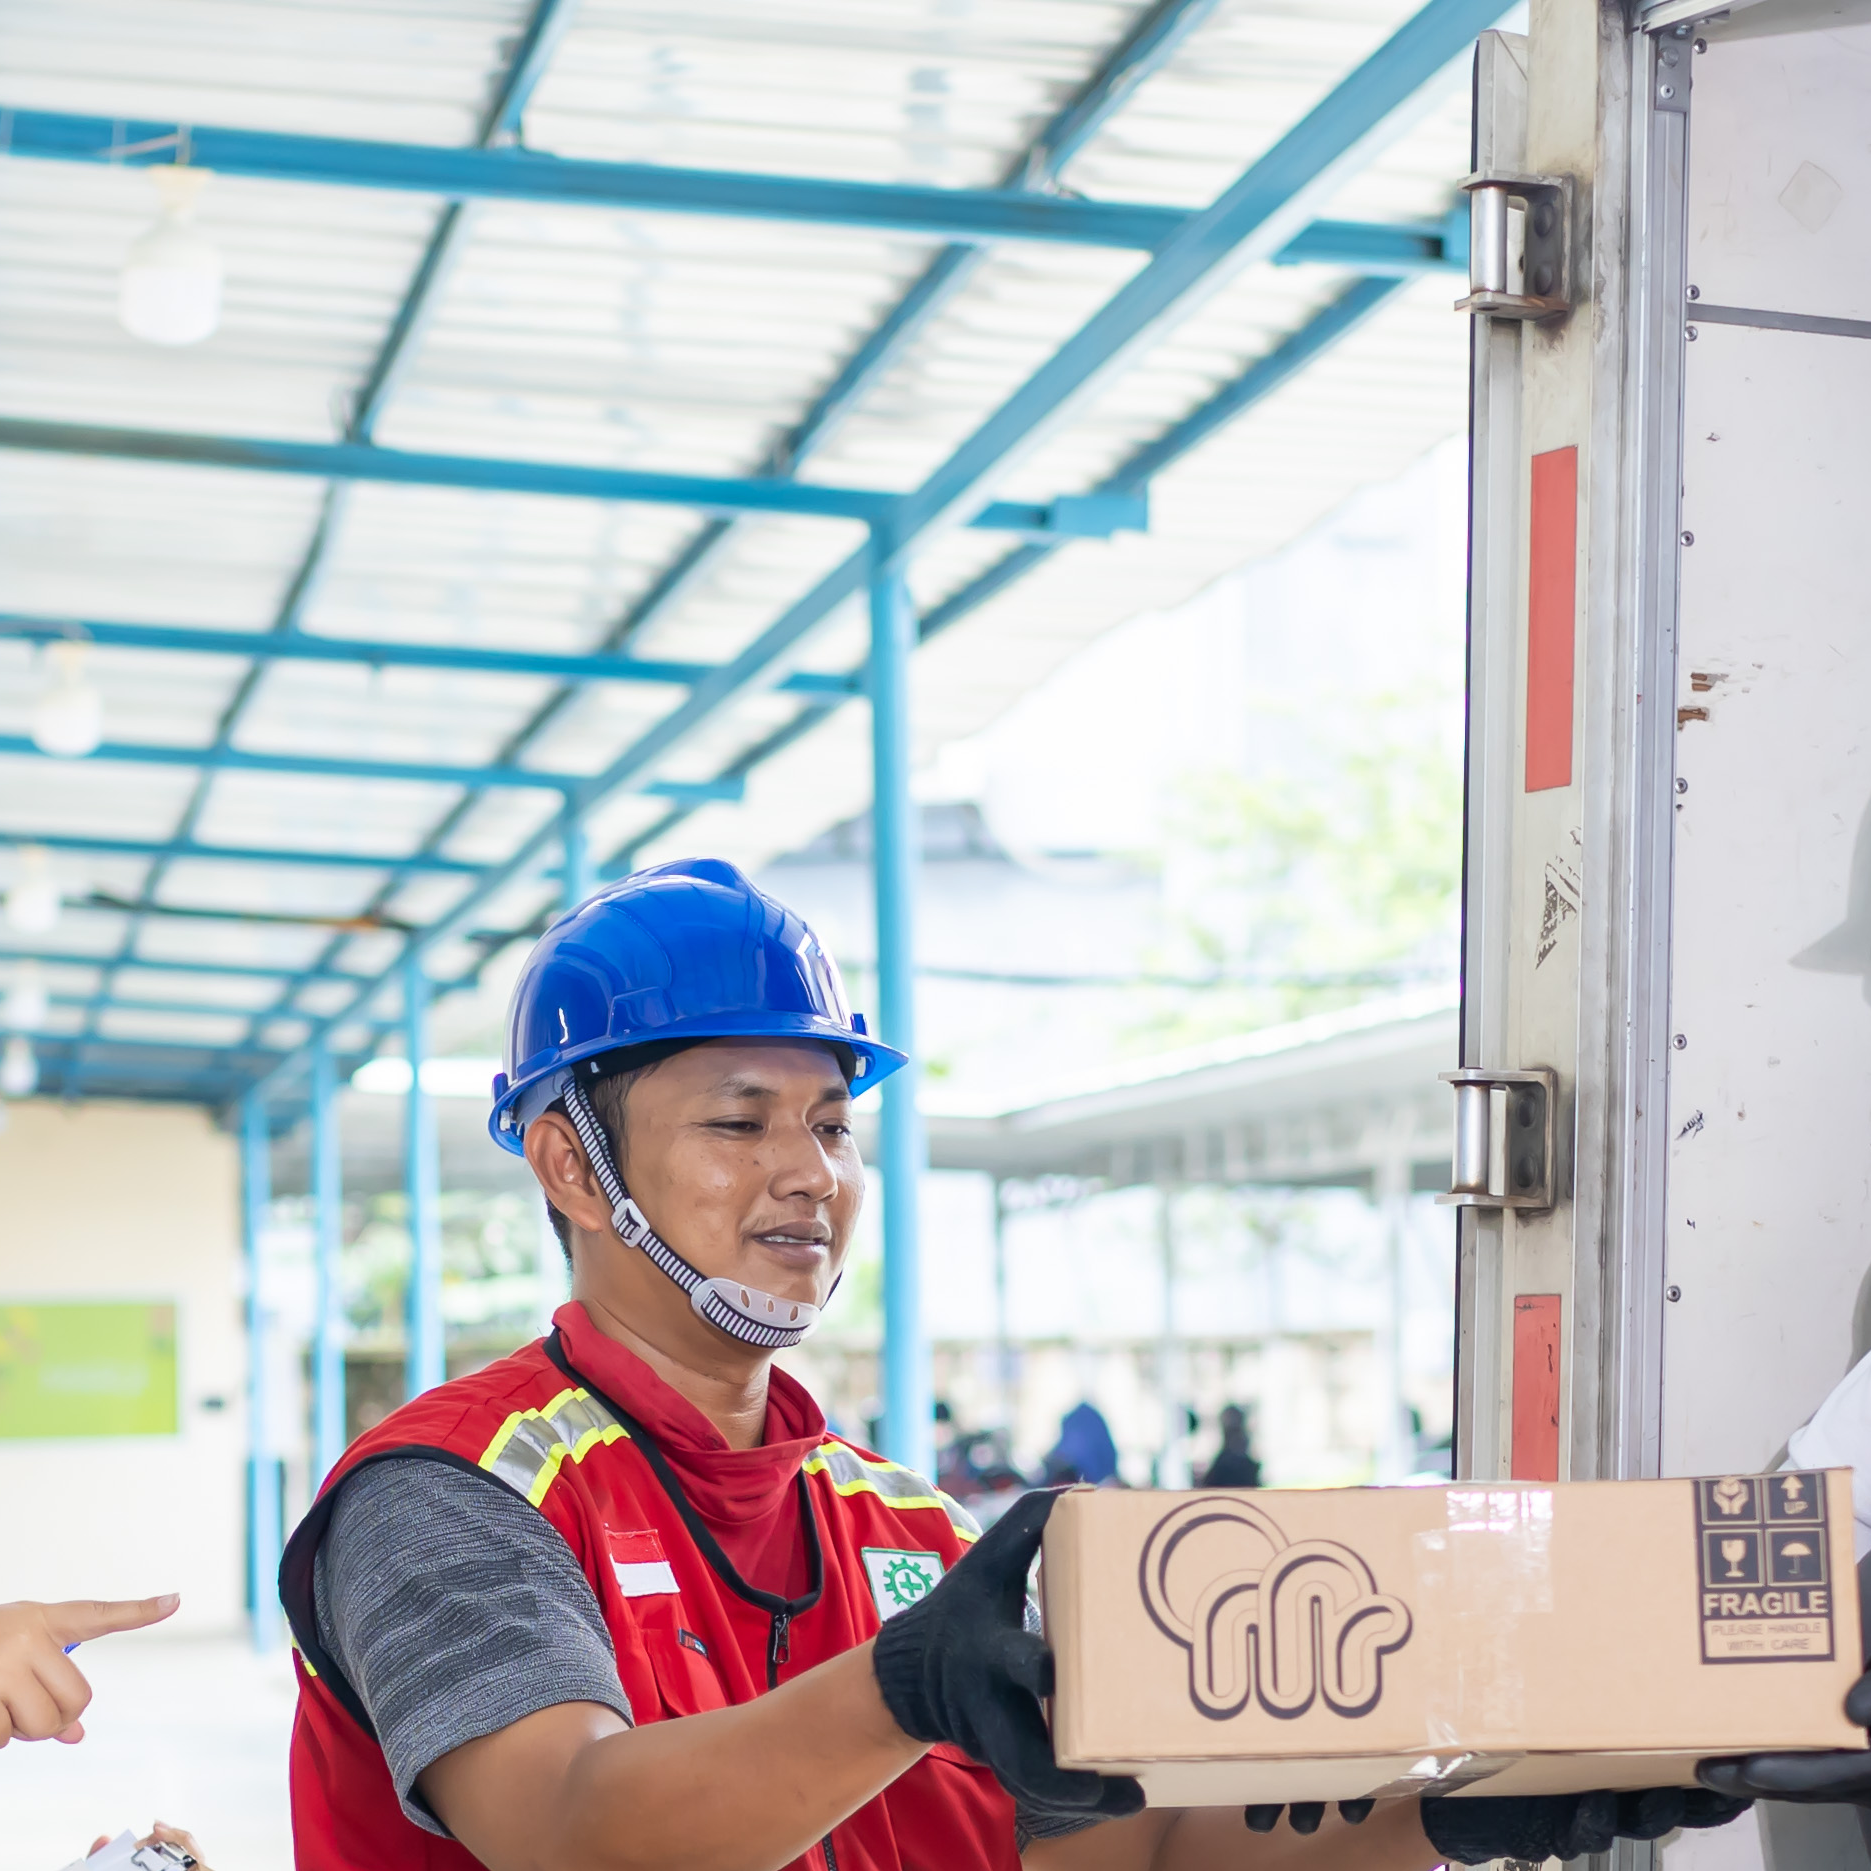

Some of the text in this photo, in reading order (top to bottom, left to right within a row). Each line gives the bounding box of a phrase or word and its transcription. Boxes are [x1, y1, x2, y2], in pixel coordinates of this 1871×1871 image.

[1784, 1500, 1809, 1514] UP
[1703, 1591, 1828, 1616] FRAGILE
[1711, 1622, 1821, 1635] PLEASE HANDLE
[1727, 1639, 1809, 1651] WITH CARE
